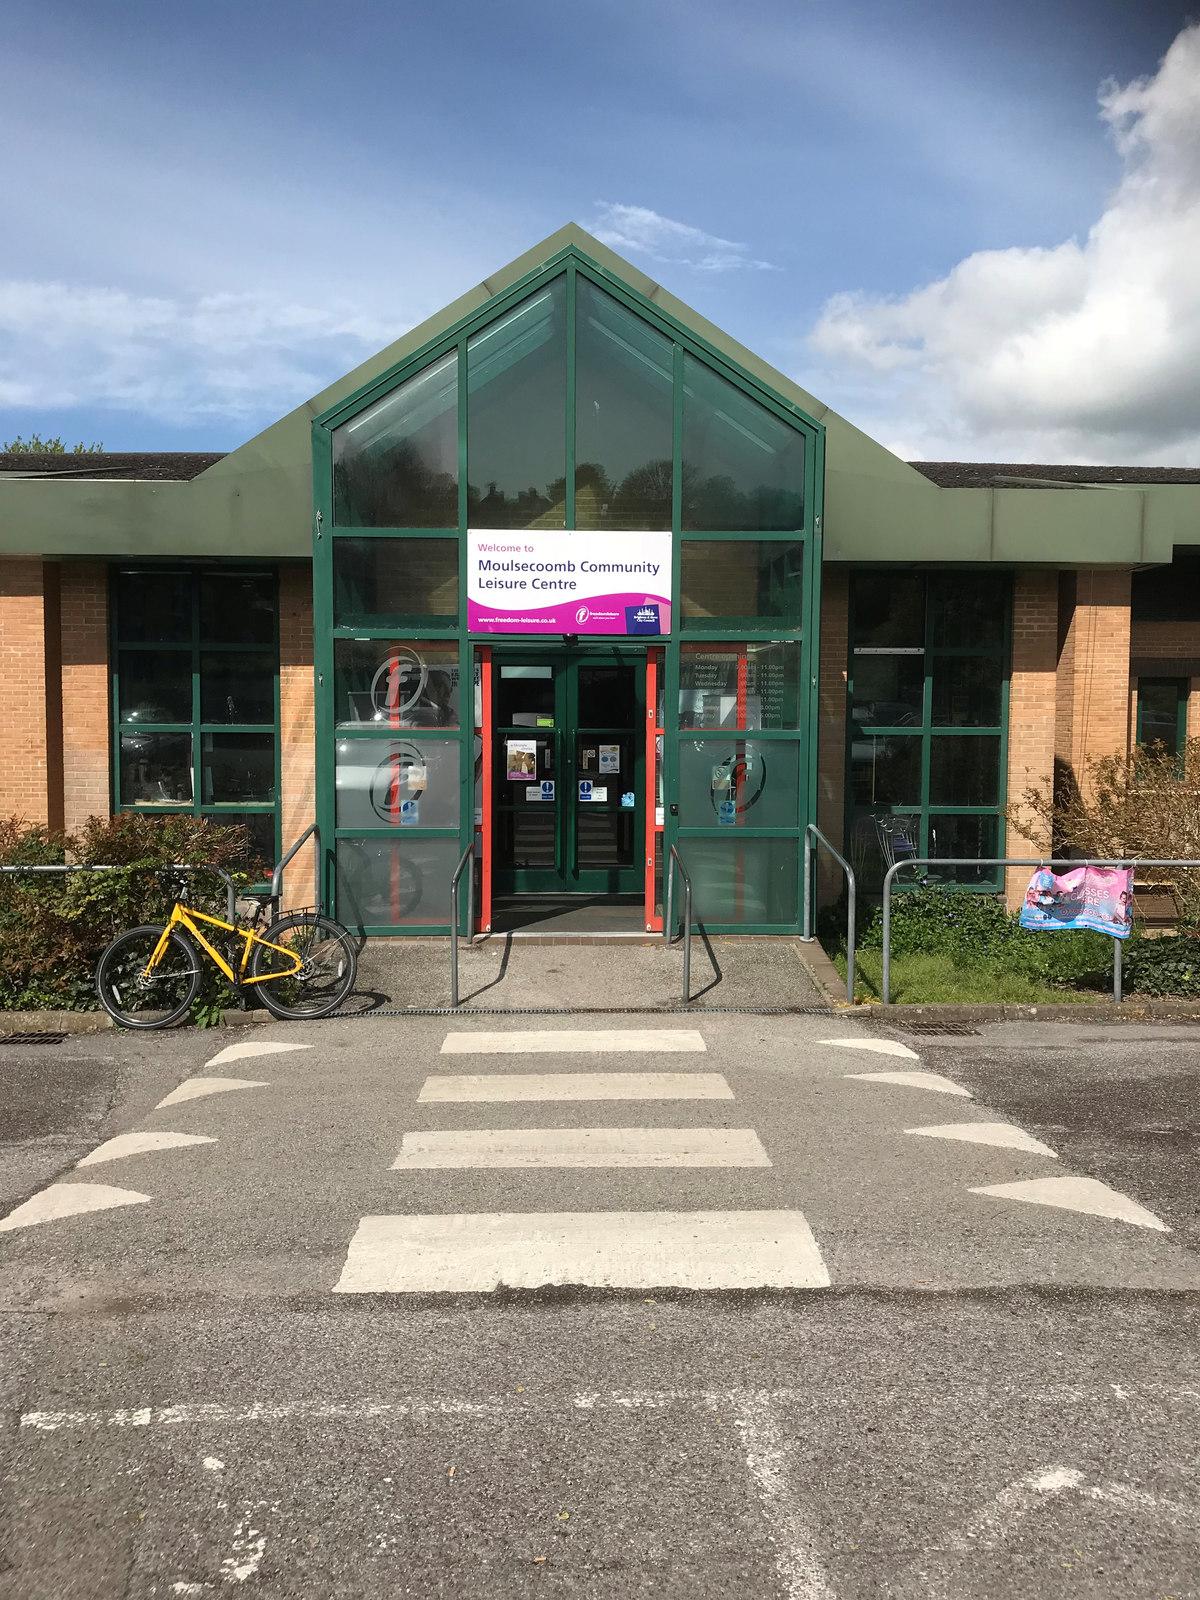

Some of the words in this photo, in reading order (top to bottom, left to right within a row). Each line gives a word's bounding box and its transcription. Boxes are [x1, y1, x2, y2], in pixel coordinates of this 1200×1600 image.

[478, 543, 521, 553] Welcome
[524, 544, 534, 553] to
[478, 559, 576, 572] Moulsecoomb
[580, 561, 660, 576] Community
[478, 577, 527, 590] Leisure
[531, 578, 577, 590] Centre
[478, 616, 557, 624] www.freedom-leisure.co.uk
[694, 664, 719, 672] Monday
[694, 672, 718, 680] Tuesday
[694, 680, 728, 688] Wednesday
